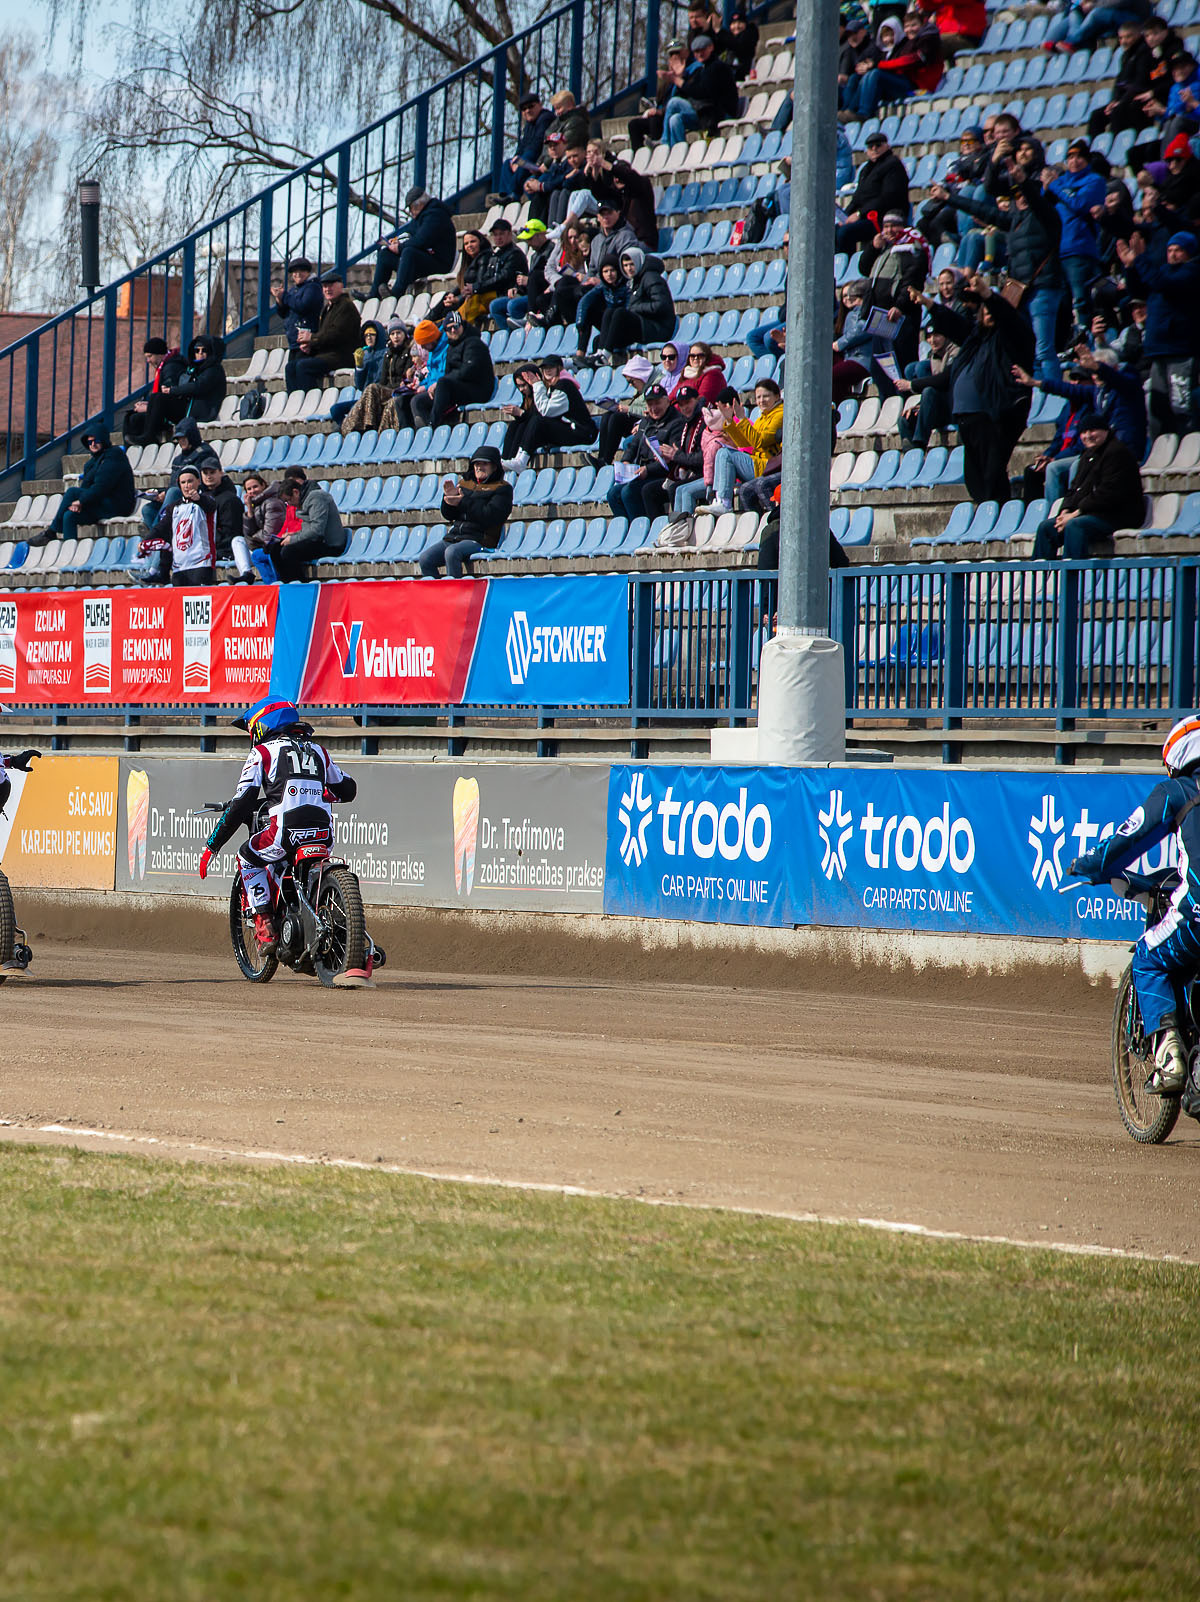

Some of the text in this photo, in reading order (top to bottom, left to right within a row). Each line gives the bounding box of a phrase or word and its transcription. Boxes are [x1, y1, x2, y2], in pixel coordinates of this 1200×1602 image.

[34, 609, 66, 632] IZCILAM
[85, 604, 110, 627] PUFAS
[129, 606, 165, 629] IZCILAM
[185, 601, 210, 625] PUFAS
[232, 604, 268, 628] IZCILAM
[26, 640, 72, 663] REMONTAM
[122, 638, 172, 661] REMONTAM
[224, 637, 275, 660] REMONTAM
[531, 625, 606, 663] STOKKER
[361, 638, 434, 678] Valvoline
[27, 669, 71, 685] WWW.PUFAS.LV
[122, 668, 171, 684] WWW.PUFAS.LV
[225, 667, 271, 683] WWW.PUFAS.L
[286, 750, 318, 776] 14
[68, 785, 114, 817] SĀC SAVU
[151, 807, 166, 837] Dr.
[168, 808, 221, 839] Trofimov
[331, 813, 388, 846] Trofimova
[481, 817, 565, 851] Dr. Trofimova
[657, 786, 772, 862] trodo
[21, 829, 115, 857] KARJERU PIE MUMS!
[860, 801, 975, 874] trodo
[390, 854, 425, 887] prakse
[480, 857, 604, 893] zobārstniecības prakse
[661, 874, 769, 903] CAR PARTS ONLINE
[863, 886, 973, 913] CAR PARTS ONLINE
[1076, 896, 1147, 922] CAR PARTS
